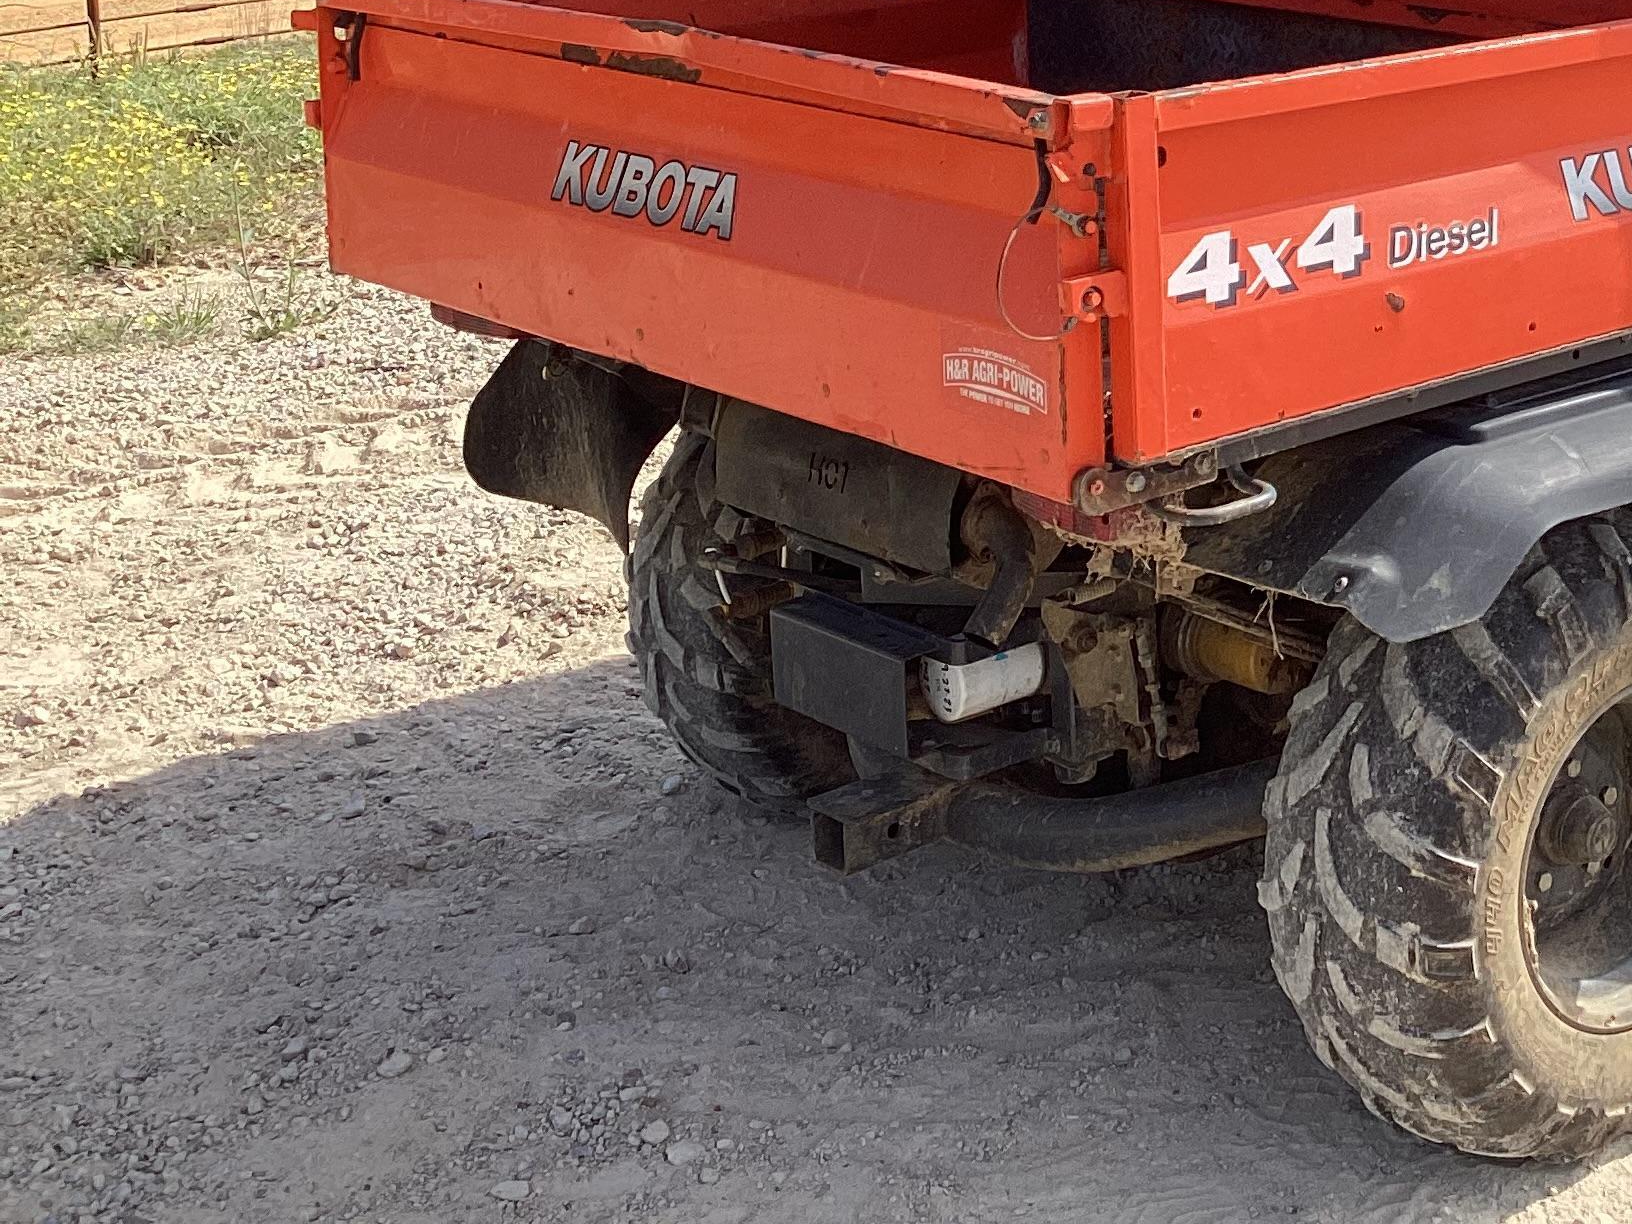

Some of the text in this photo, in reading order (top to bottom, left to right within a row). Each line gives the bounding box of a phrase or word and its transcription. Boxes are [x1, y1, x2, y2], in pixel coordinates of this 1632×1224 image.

[551, 140, 737, 241] KUBOTA
[1167, 203, 1500, 310] 4x4 Diesel
[946, 359, 1044, 407] H&R AGRI-POWER
